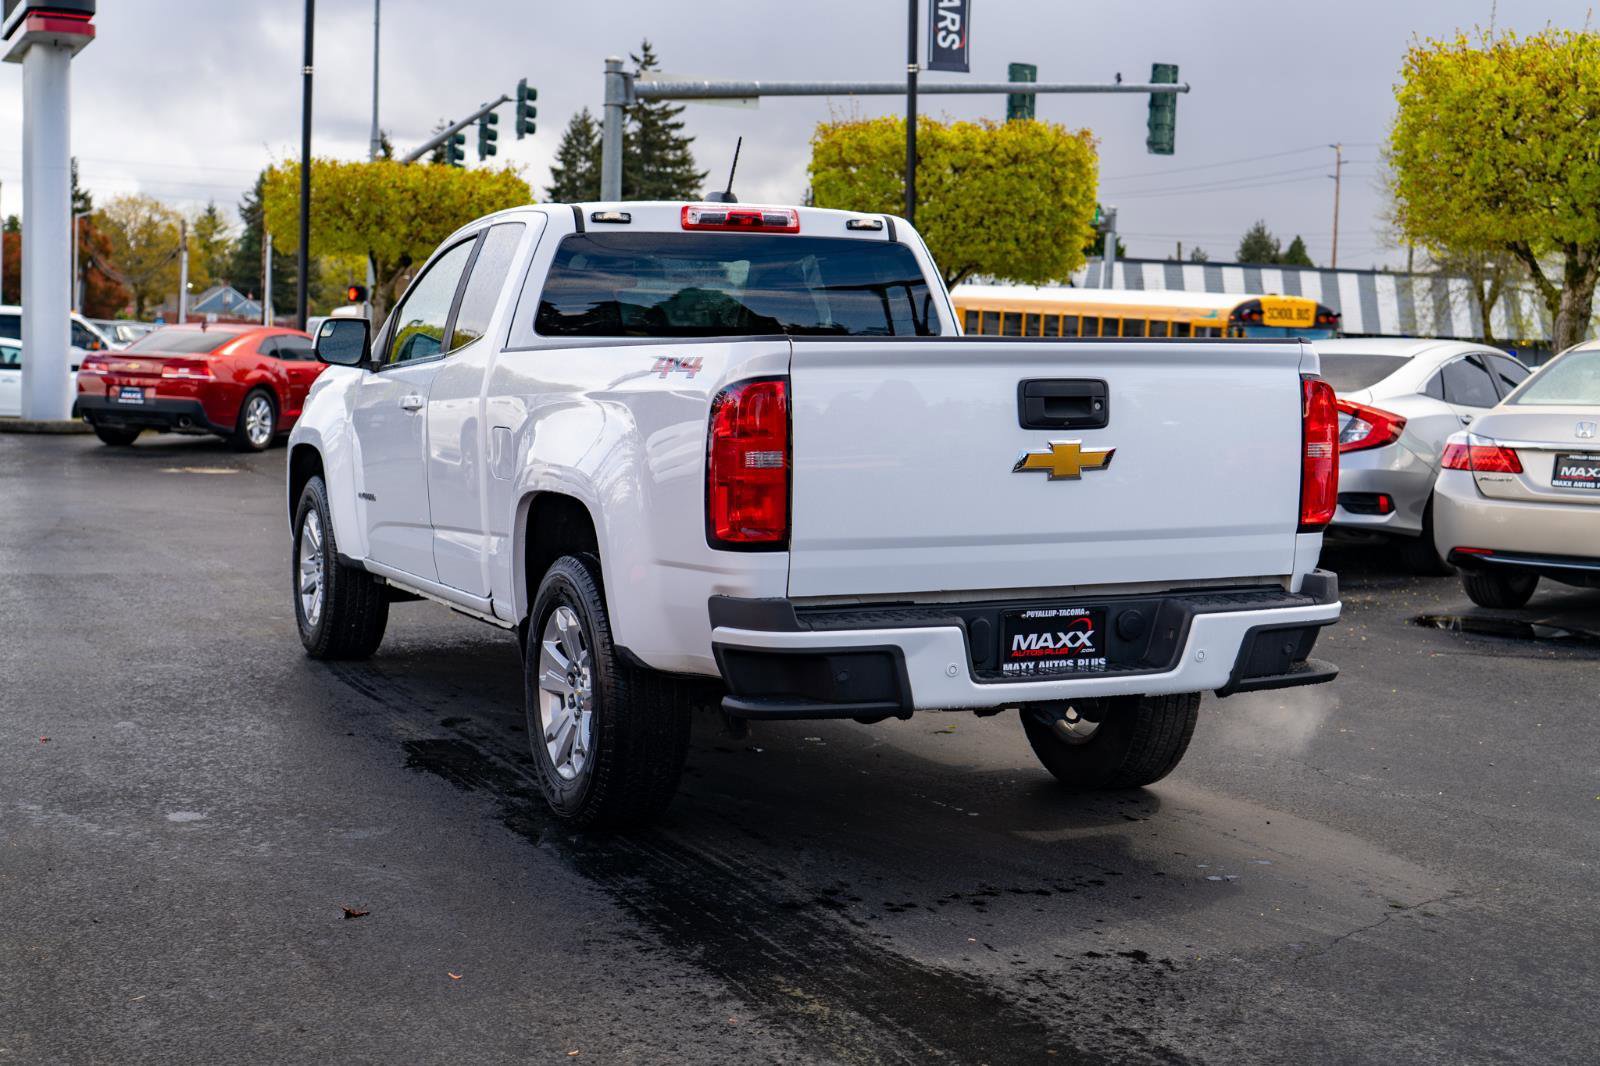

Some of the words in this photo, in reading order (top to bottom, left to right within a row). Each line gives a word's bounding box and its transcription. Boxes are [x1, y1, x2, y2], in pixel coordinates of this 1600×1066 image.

[1267, 307, 1294, 320] SCHOOL
[1296, 308, 1310, 320] BUS
[1026, 608, 1085, 618] PUYALLUP-TACOMA
[1012, 630, 1095, 651] MAXX
[1012, 648, 1044, 657] AUTOS
[1045, 647, 1069, 655] PLUS
